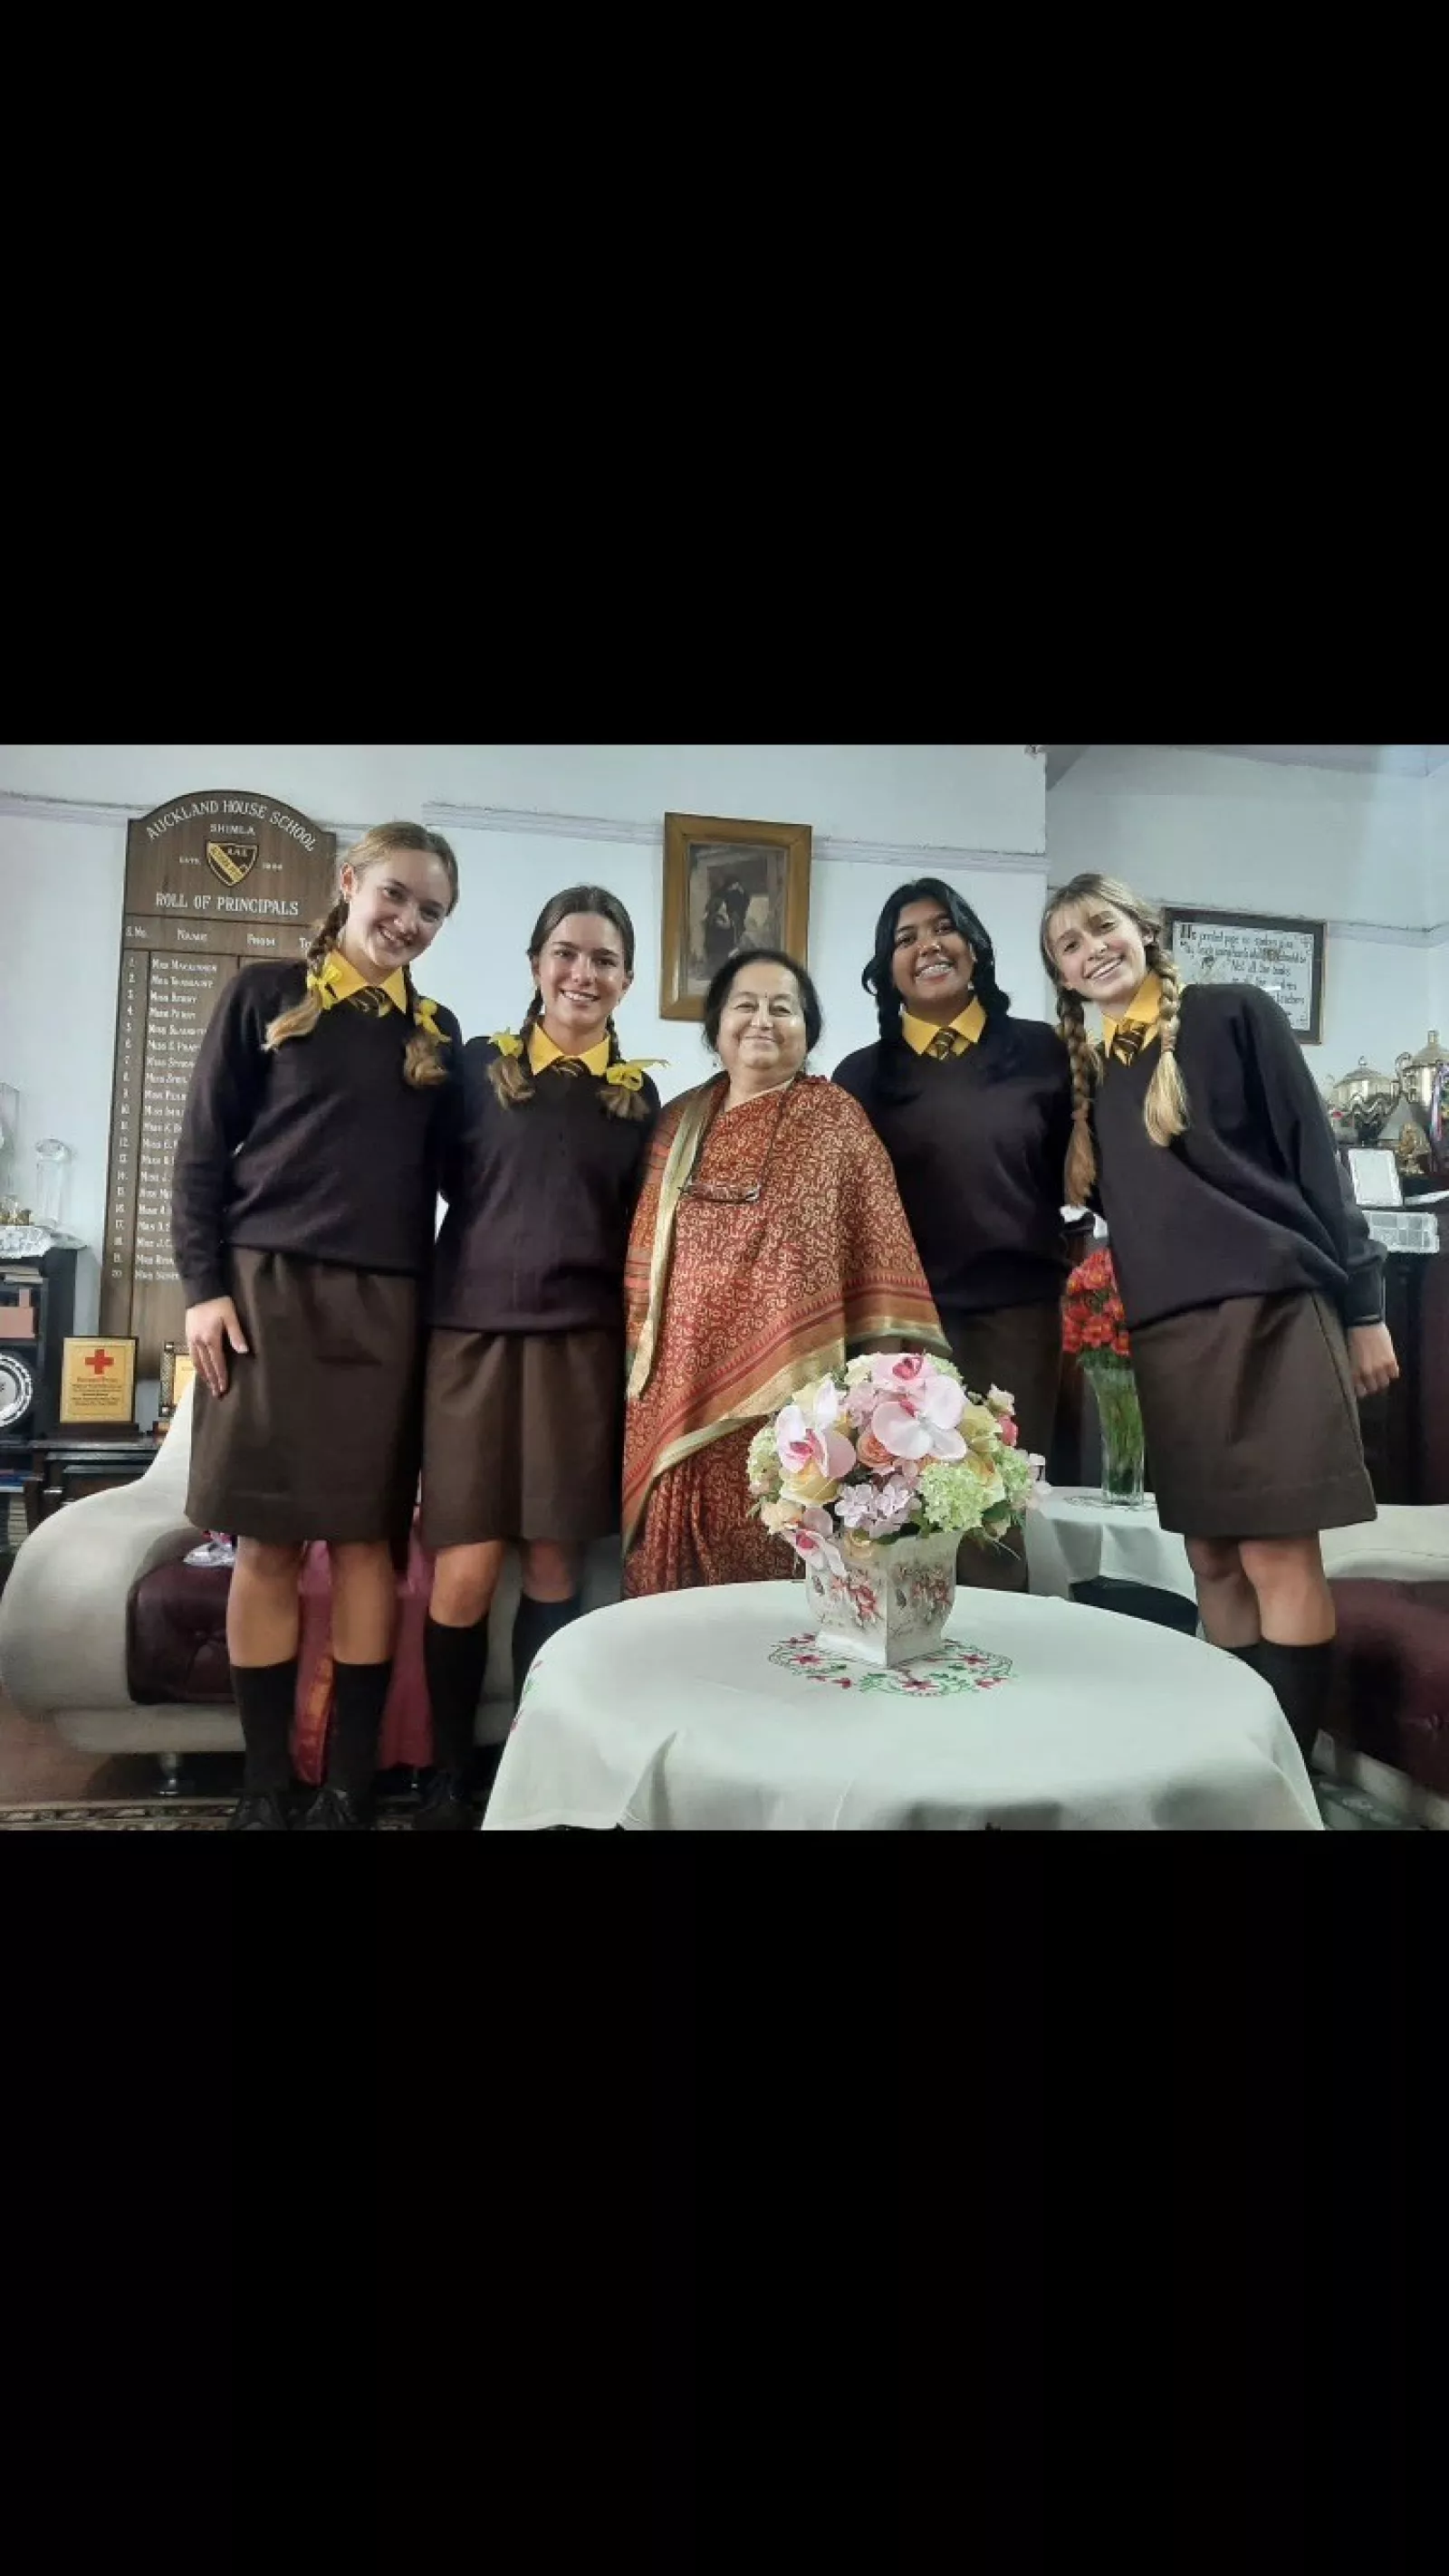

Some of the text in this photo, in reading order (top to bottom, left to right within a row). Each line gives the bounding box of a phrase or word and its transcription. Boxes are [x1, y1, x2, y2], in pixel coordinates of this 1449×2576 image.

[146, 800, 317, 853] AUCKLAND HOUSE SCHOOL
[209, 823, 256, 836] SHIMLA
[156, 891, 300, 915] ROLL OF PRINCIPALS
